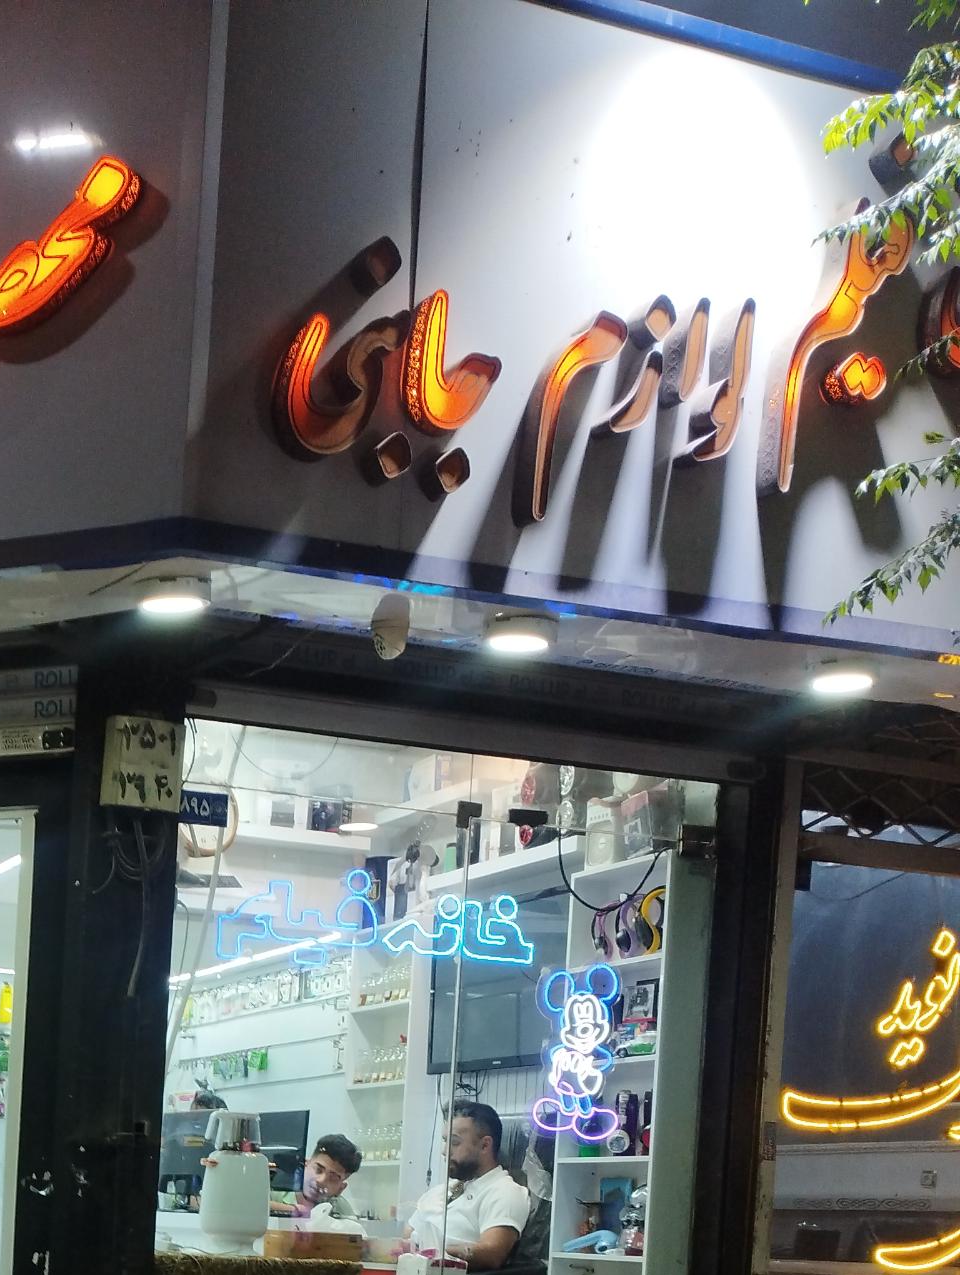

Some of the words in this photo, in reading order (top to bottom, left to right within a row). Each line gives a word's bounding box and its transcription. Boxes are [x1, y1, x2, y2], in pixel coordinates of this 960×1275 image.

[270, 235, 504, 502] جانبی
[512, 292, 756, 528] لوازم
[215, 868, 379, 968] فیلم
[381, 892, 535, 967] خانه
